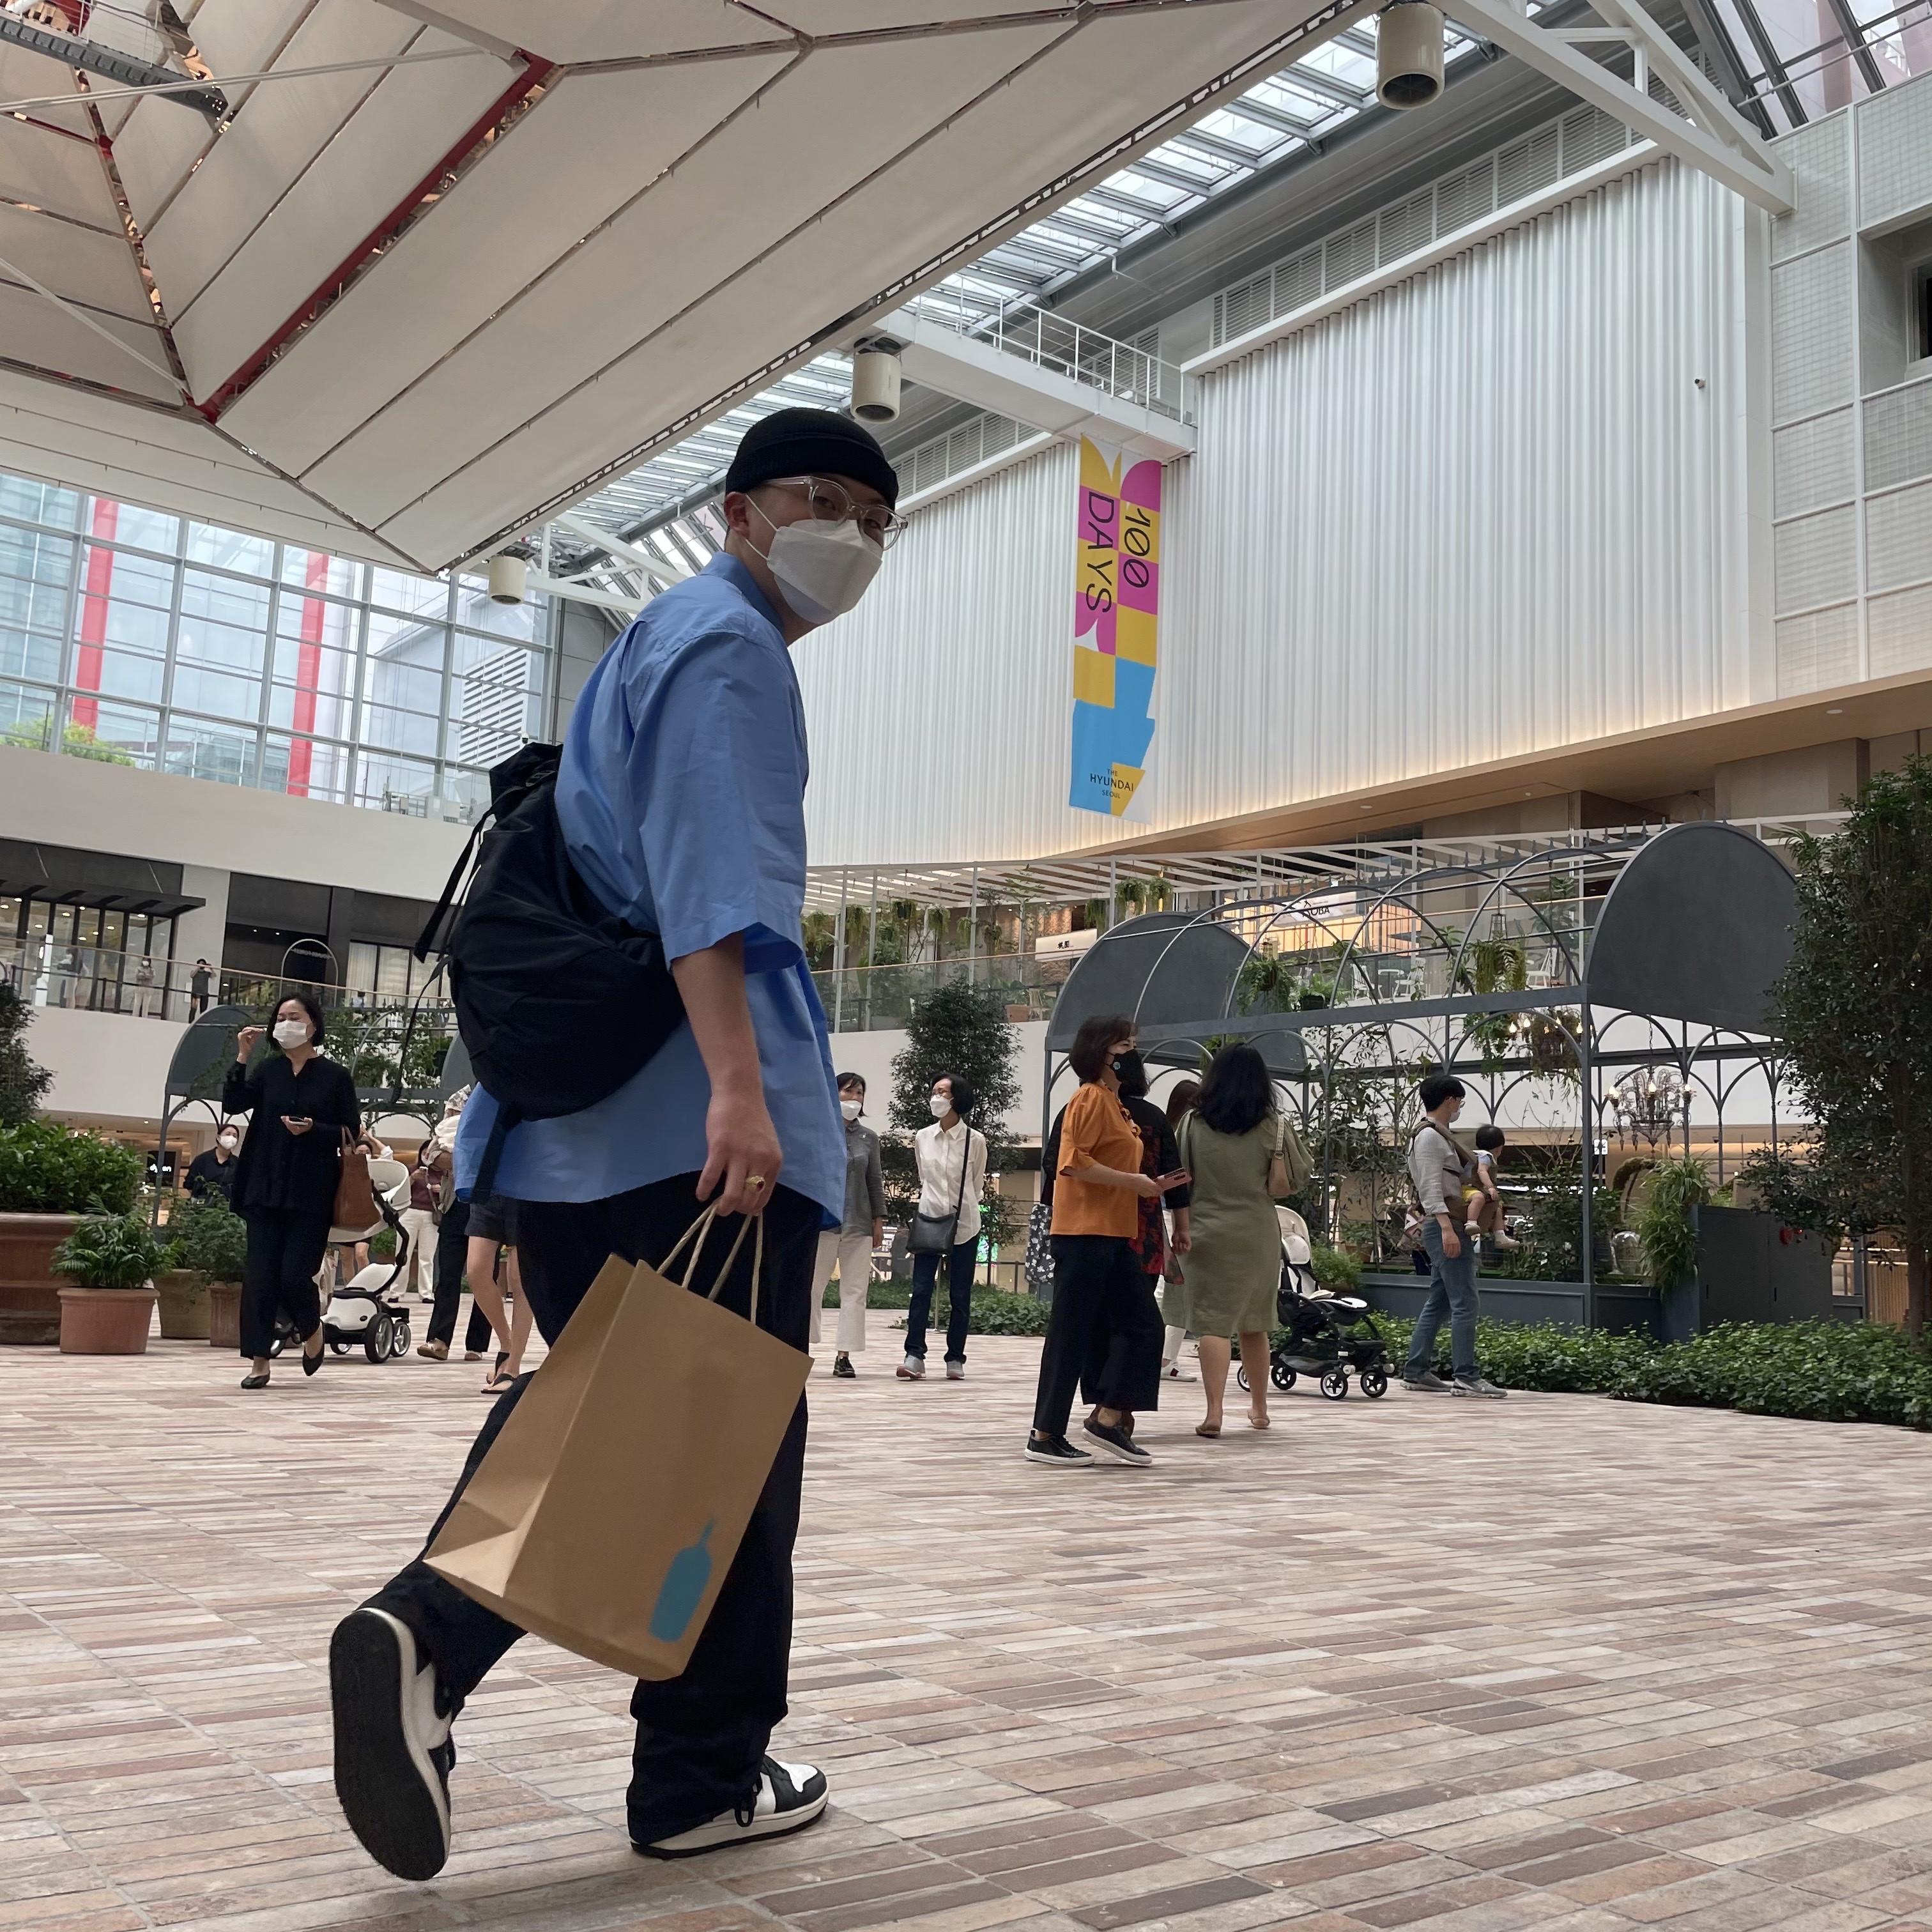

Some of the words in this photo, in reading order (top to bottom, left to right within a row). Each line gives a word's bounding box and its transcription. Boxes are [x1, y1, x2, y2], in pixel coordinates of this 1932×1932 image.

[1085, 491, 1114, 612] DAYS
[1123, 509, 1151, 588] 100
[1090, 773, 1134, 792] HYUNDAI
[1107, 769, 1118, 777] THE
[1101, 789, 1121, 799] SEOUL
